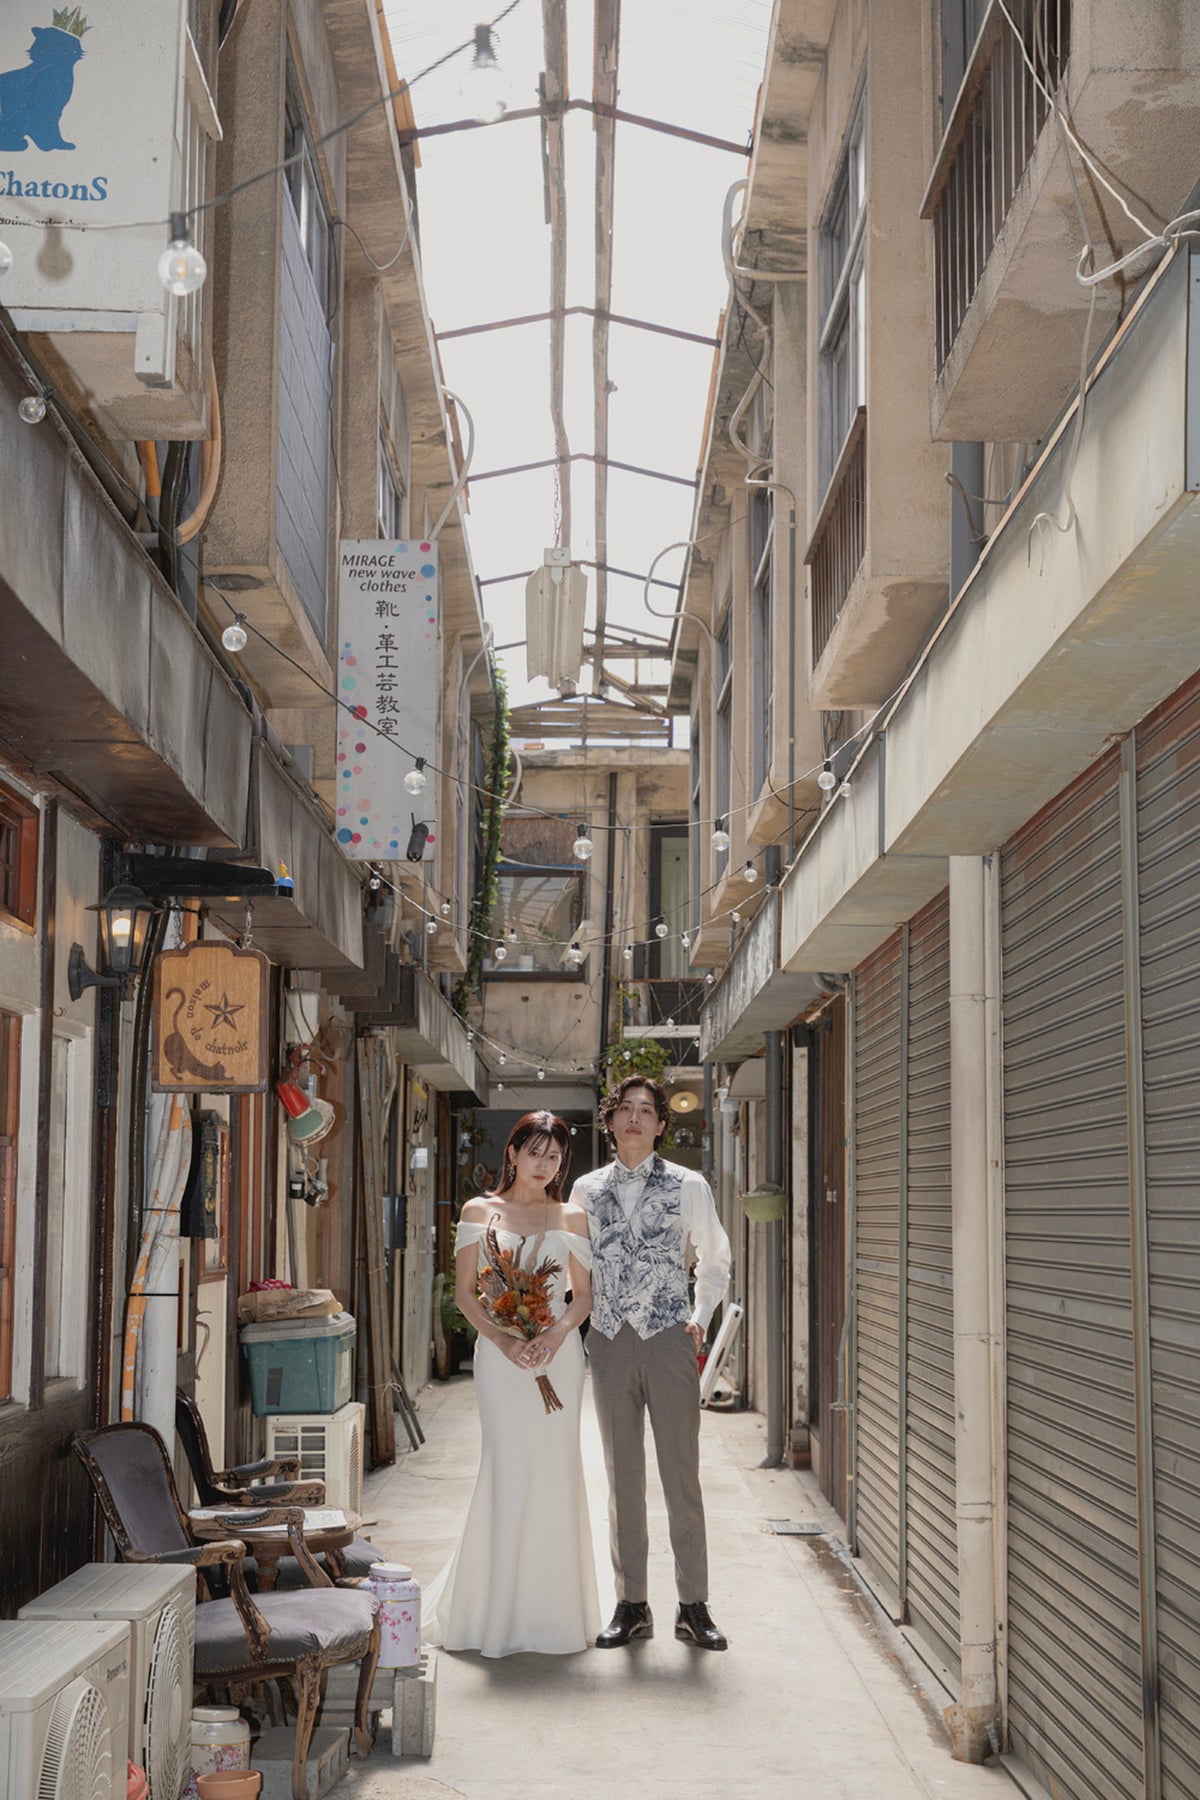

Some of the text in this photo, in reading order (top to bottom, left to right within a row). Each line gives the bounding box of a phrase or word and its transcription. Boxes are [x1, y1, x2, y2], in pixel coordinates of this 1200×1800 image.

[342, 554, 396, 567] MIRAGE
[348, 568, 416, 580] new wave
[359, 579, 407, 593] clothes
[374, 600, 400, 736] 靴・革工芸教室
